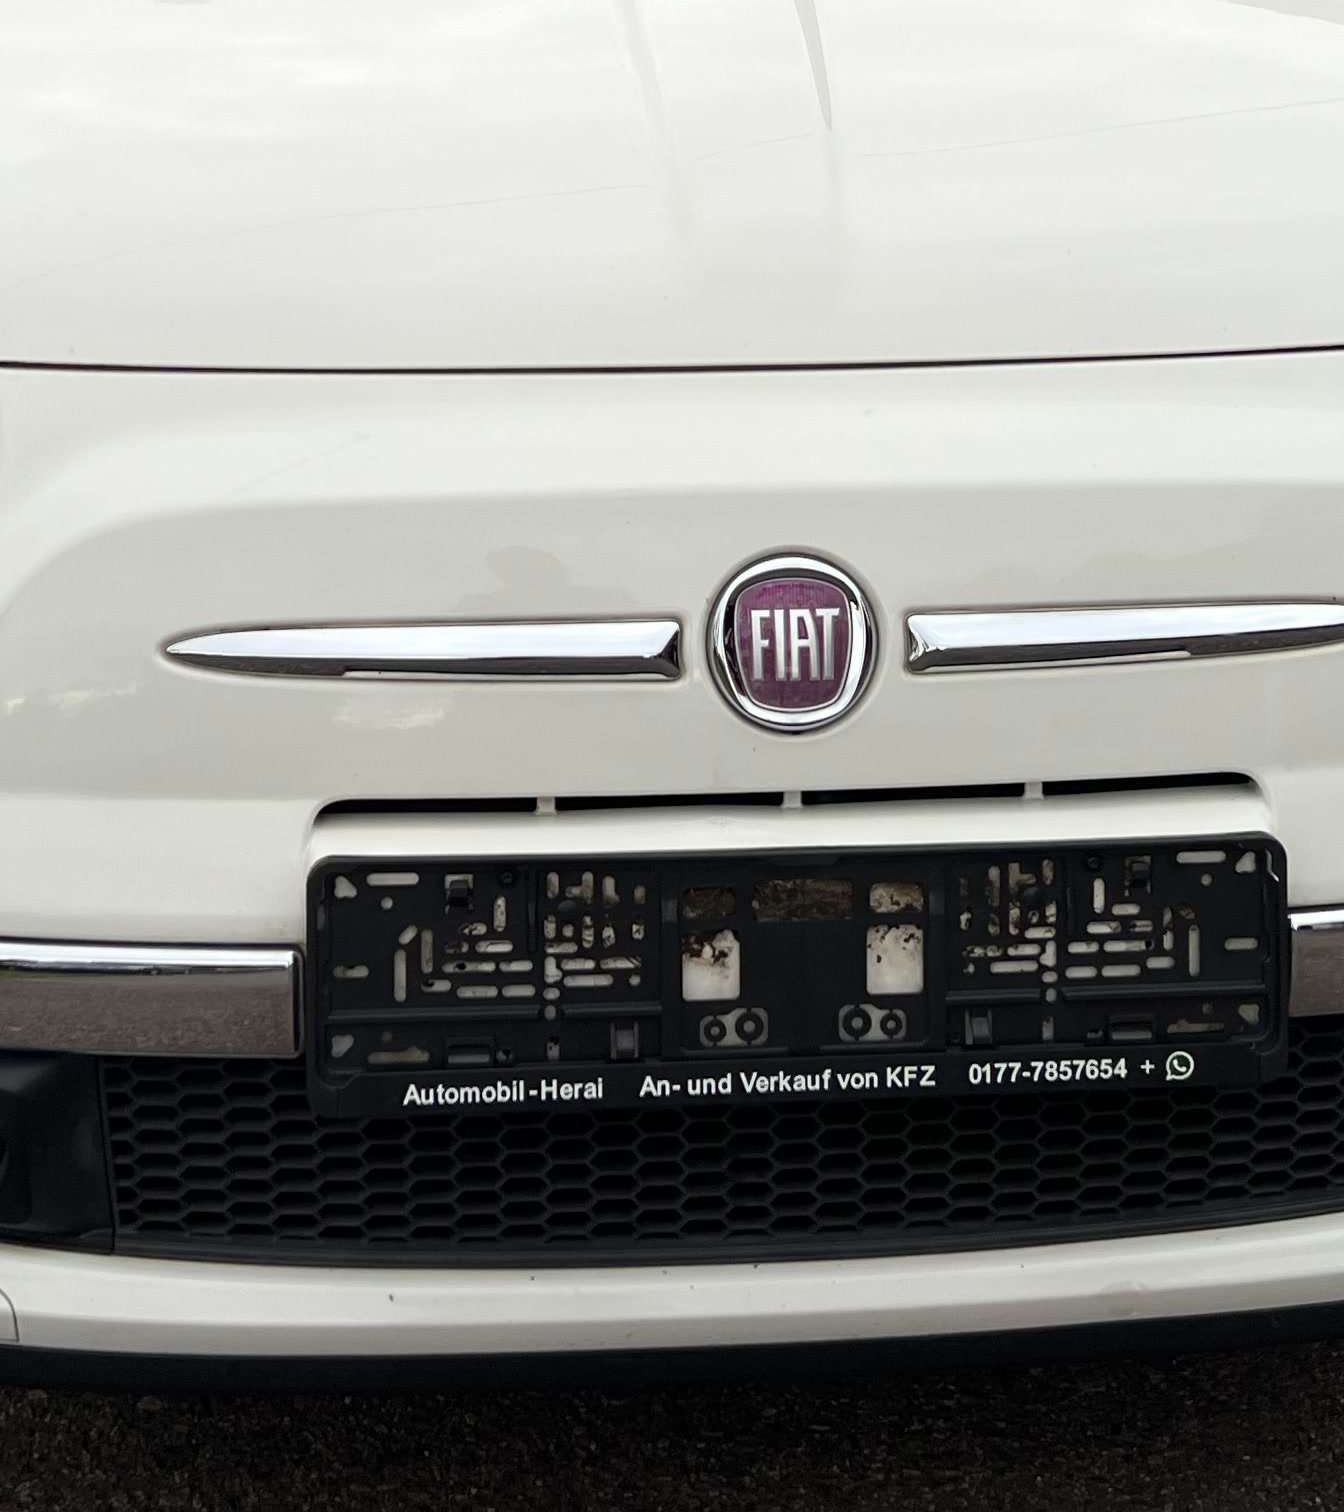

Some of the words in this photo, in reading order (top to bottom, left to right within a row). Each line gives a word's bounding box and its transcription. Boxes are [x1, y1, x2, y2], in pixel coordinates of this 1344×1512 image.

[750, 607, 840, 681] FIAT
[402, 1079, 604, 1106] Automobil-Herai
[639, 1075, 682, 1098] An-
[687, 1072, 732, 1096] und
[739, 1068, 832, 1094] Verkauf
[836, 1071, 879, 1090] von
[886, 1065, 936, 1088] KFZ
[968, 1057, 1128, 1085] 0177-7857654
